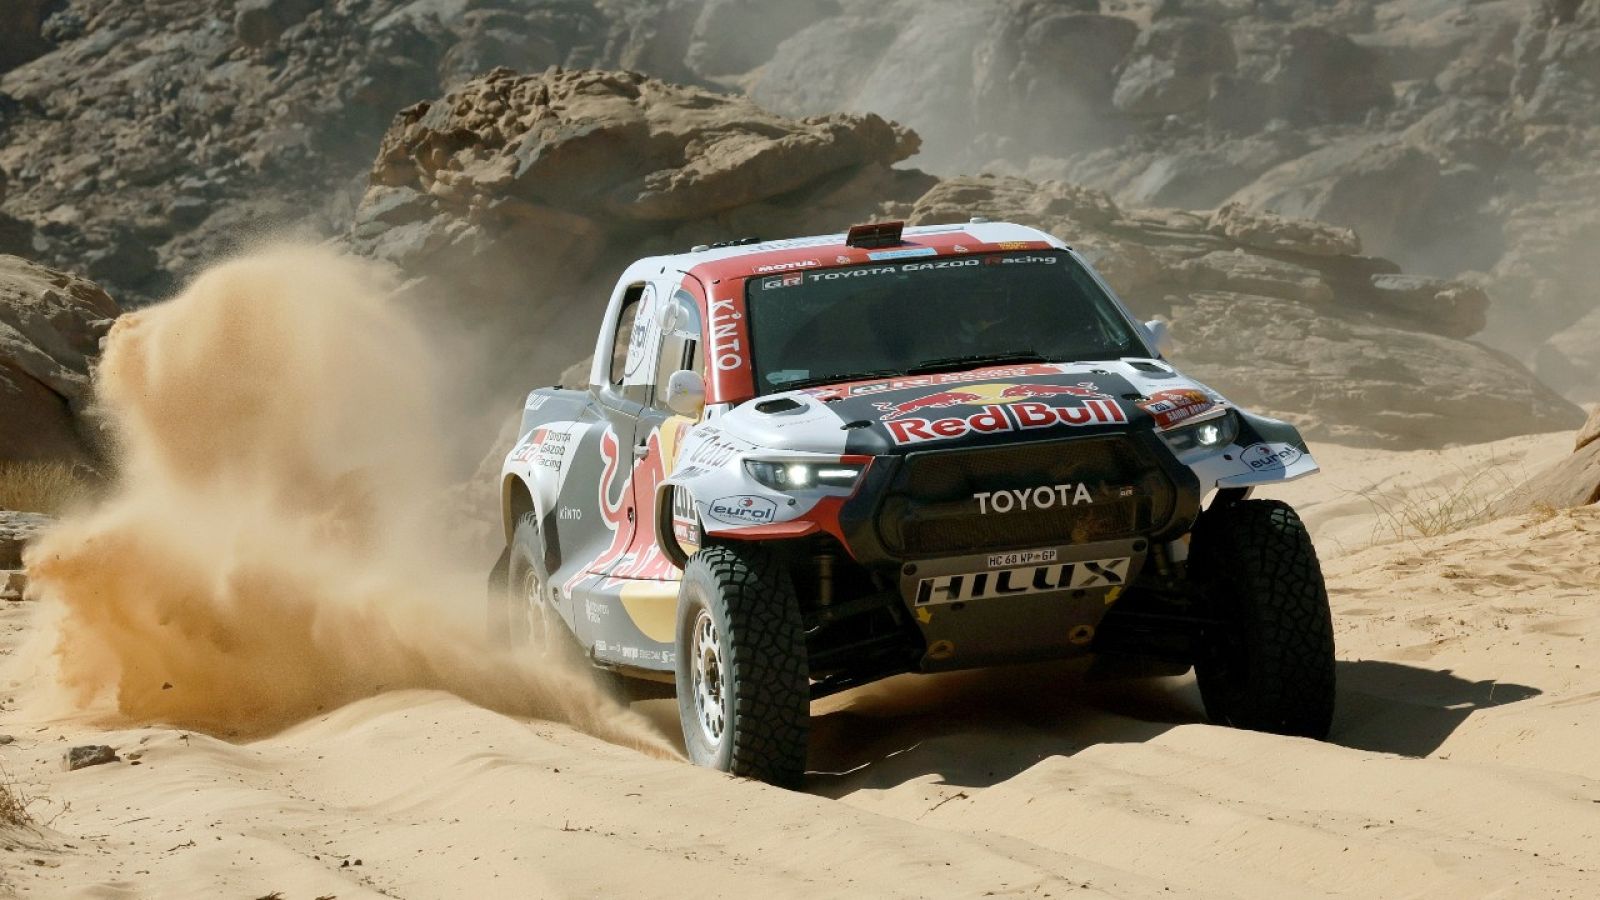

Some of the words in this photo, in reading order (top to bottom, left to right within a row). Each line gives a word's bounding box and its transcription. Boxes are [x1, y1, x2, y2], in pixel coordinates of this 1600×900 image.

[758, 260, 817, 272] MOTUL
[764, 276, 801, 290] GR
[808, 266, 896, 282] TOYOTA
[901, 259, 980, 272] GAZOO
[984, 255, 1057, 267] Racing
[885, 405, 1012, 443] Red
[1010, 400, 1127, 428] Bull
[1250, 446, 1292, 468] eurol
[713, 505, 772, 519] eurol
[973, 482, 1093, 515] TOYOTA
[989, 556, 1003, 567] HC
[1004, 554, 1017, 564] 68
[1020, 553, 1034, 563] WP
[1042, 550, 1056, 561] GP
[917, 559, 1126, 603] HILUX
